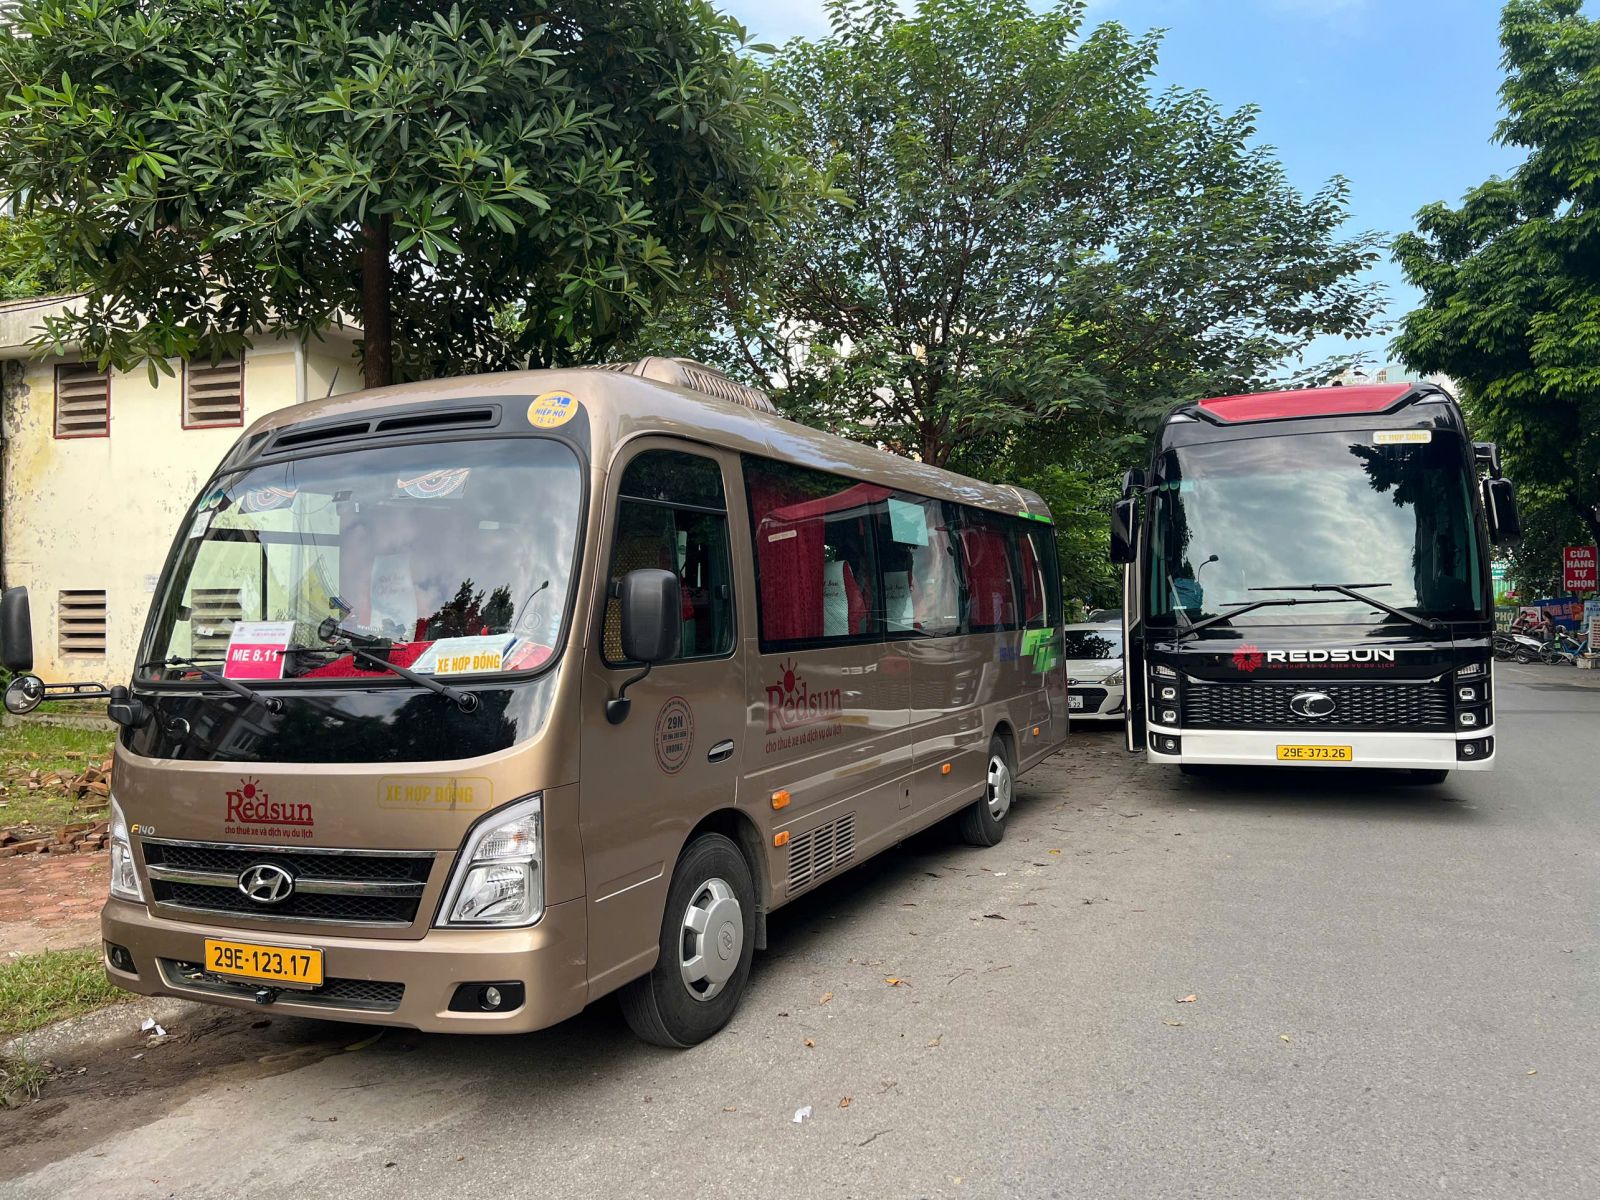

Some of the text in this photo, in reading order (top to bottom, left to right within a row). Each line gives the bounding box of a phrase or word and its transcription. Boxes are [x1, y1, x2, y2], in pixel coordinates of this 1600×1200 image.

[1570, 548, 1590, 558] CỬA
[1566, 559, 1595, 568] HÀNG
[1574, 569, 1588, 579] TỰ
[1567, 580, 1595, 590] CHỌN
[232, 649, 278, 662] ME 8.11
[1267, 648, 1395, 662] REDSUN
[437, 658, 449, 673] XE
[452, 655, 471, 674] HỢP
[765, 682, 842, 736] Redsun
[668, 716, 683, 730] 29N
[765, 723, 842, 753] cho thuê xe và dịch vụ du lịch
[1283, 747, 1346, 758] 29E-373.26
[386, 784, 400, 801] XE
[405, 784, 432, 806] HỢP
[225, 791, 314, 826] Redsun
[131, 823, 155, 835] F140
[225, 826, 236, 834] cho
[236, 826, 250, 835] thuê
[260, 827, 267, 836] và
[268, 827, 281, 838] dịch
[282, 829, 291, 838] vụ
[291, 828, 300, 837] du
[301, 829, 313, 839] lịch
[214, 946, 311, 977] 29E-123.17
